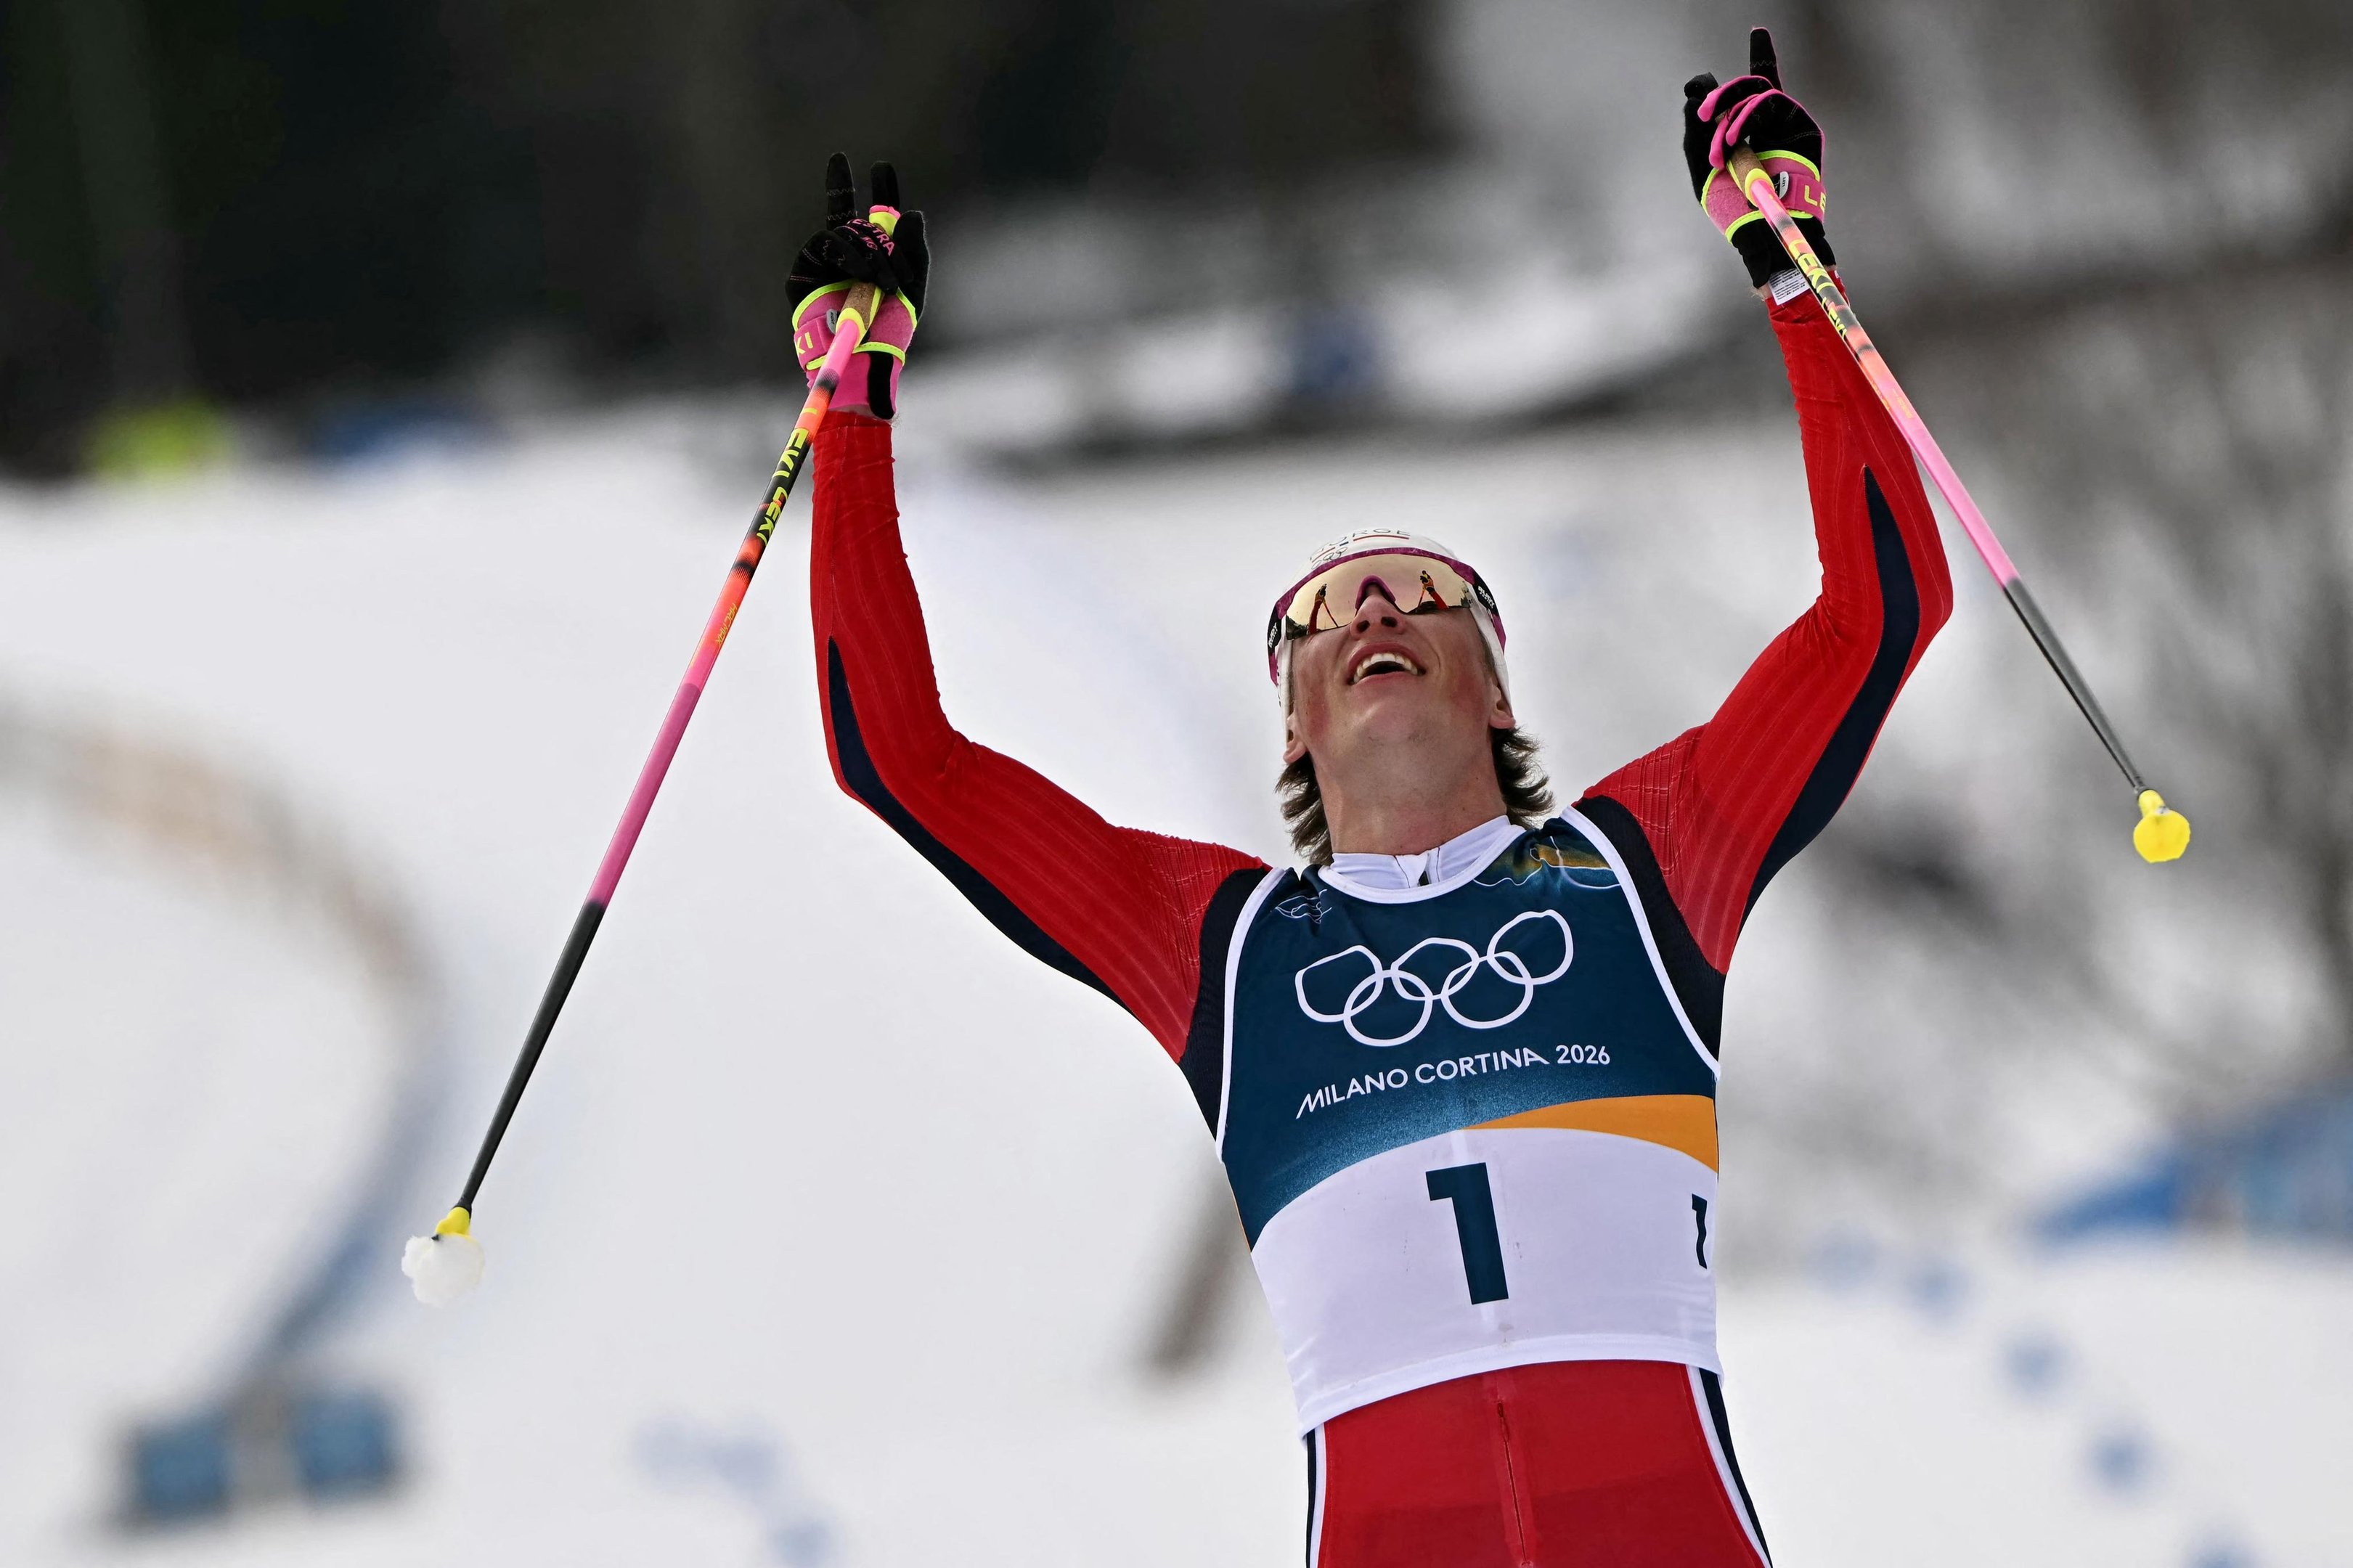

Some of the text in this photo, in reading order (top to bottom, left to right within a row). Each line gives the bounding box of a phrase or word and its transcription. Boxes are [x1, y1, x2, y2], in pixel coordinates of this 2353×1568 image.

[1788, 239, 1834, 294] LEKI
[1296, 1044, 1611, 1119] MILANO CORTINA 2026
[1425, 1162, 1509, 1305] 1
[1692, 1193, 1708, 1270] 1
